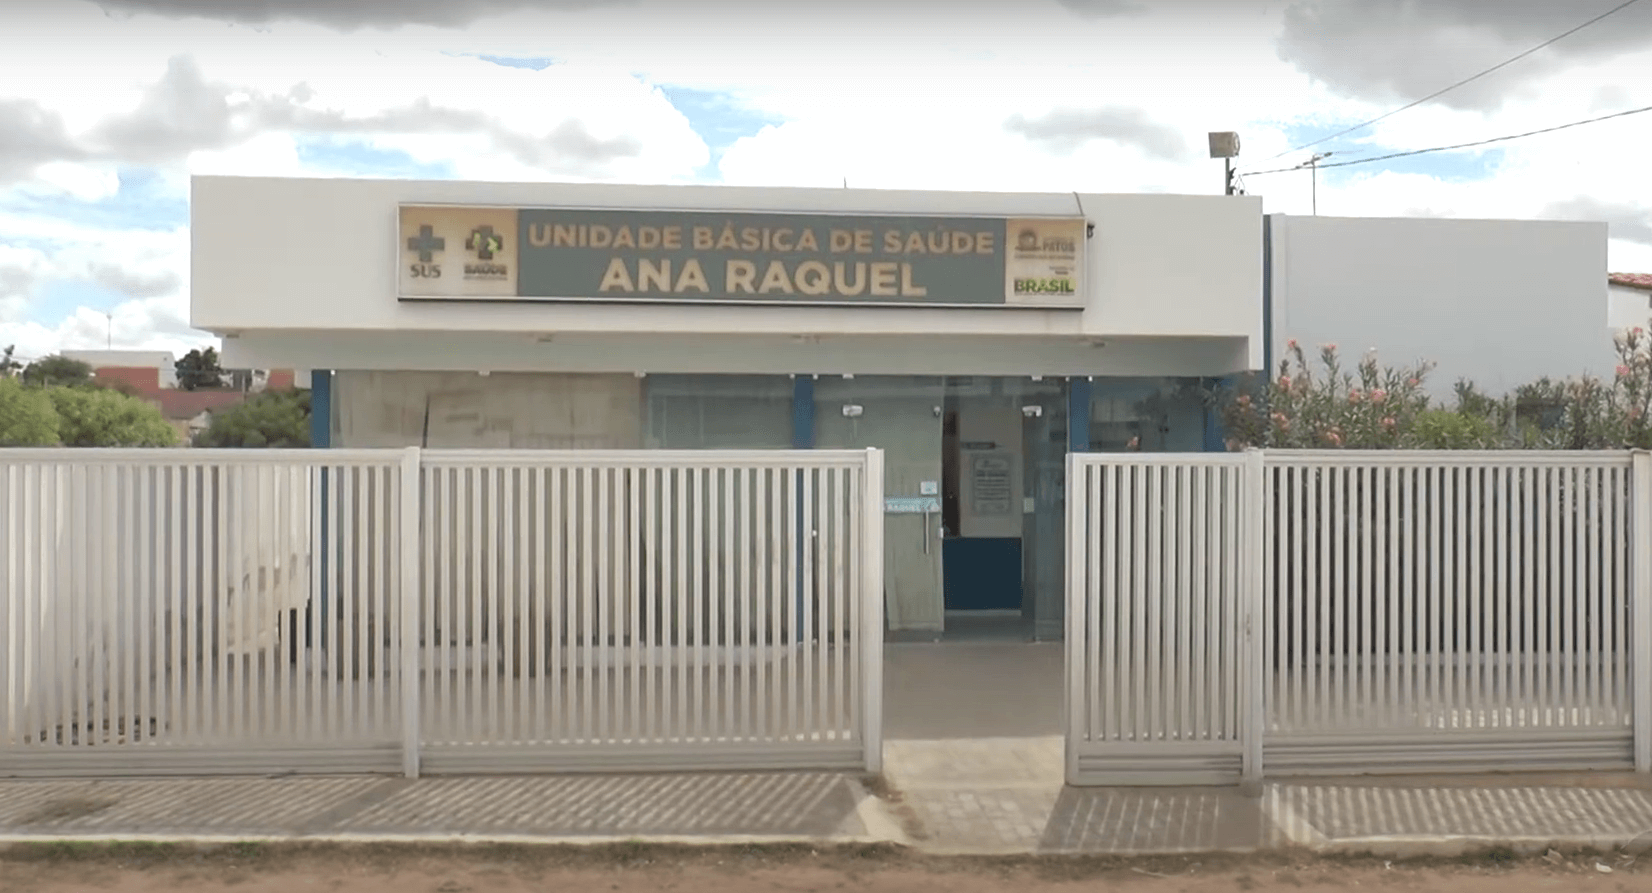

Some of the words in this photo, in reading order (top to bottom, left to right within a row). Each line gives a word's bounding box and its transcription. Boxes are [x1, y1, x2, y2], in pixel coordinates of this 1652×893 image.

[528, 223, 682, 248] UNIDADE
[693, 220, 818, 251] BÁSICA
[830, 228, 873, 253] DE
[884, 225, 994, 254] SAÚDE
[410, 264, 441, 278] SUS
[600, 257, 709, 292] ANA
[725, 259, 927, 296] RAQUEL
[1014, 279, 1074, 292] BRASIL
